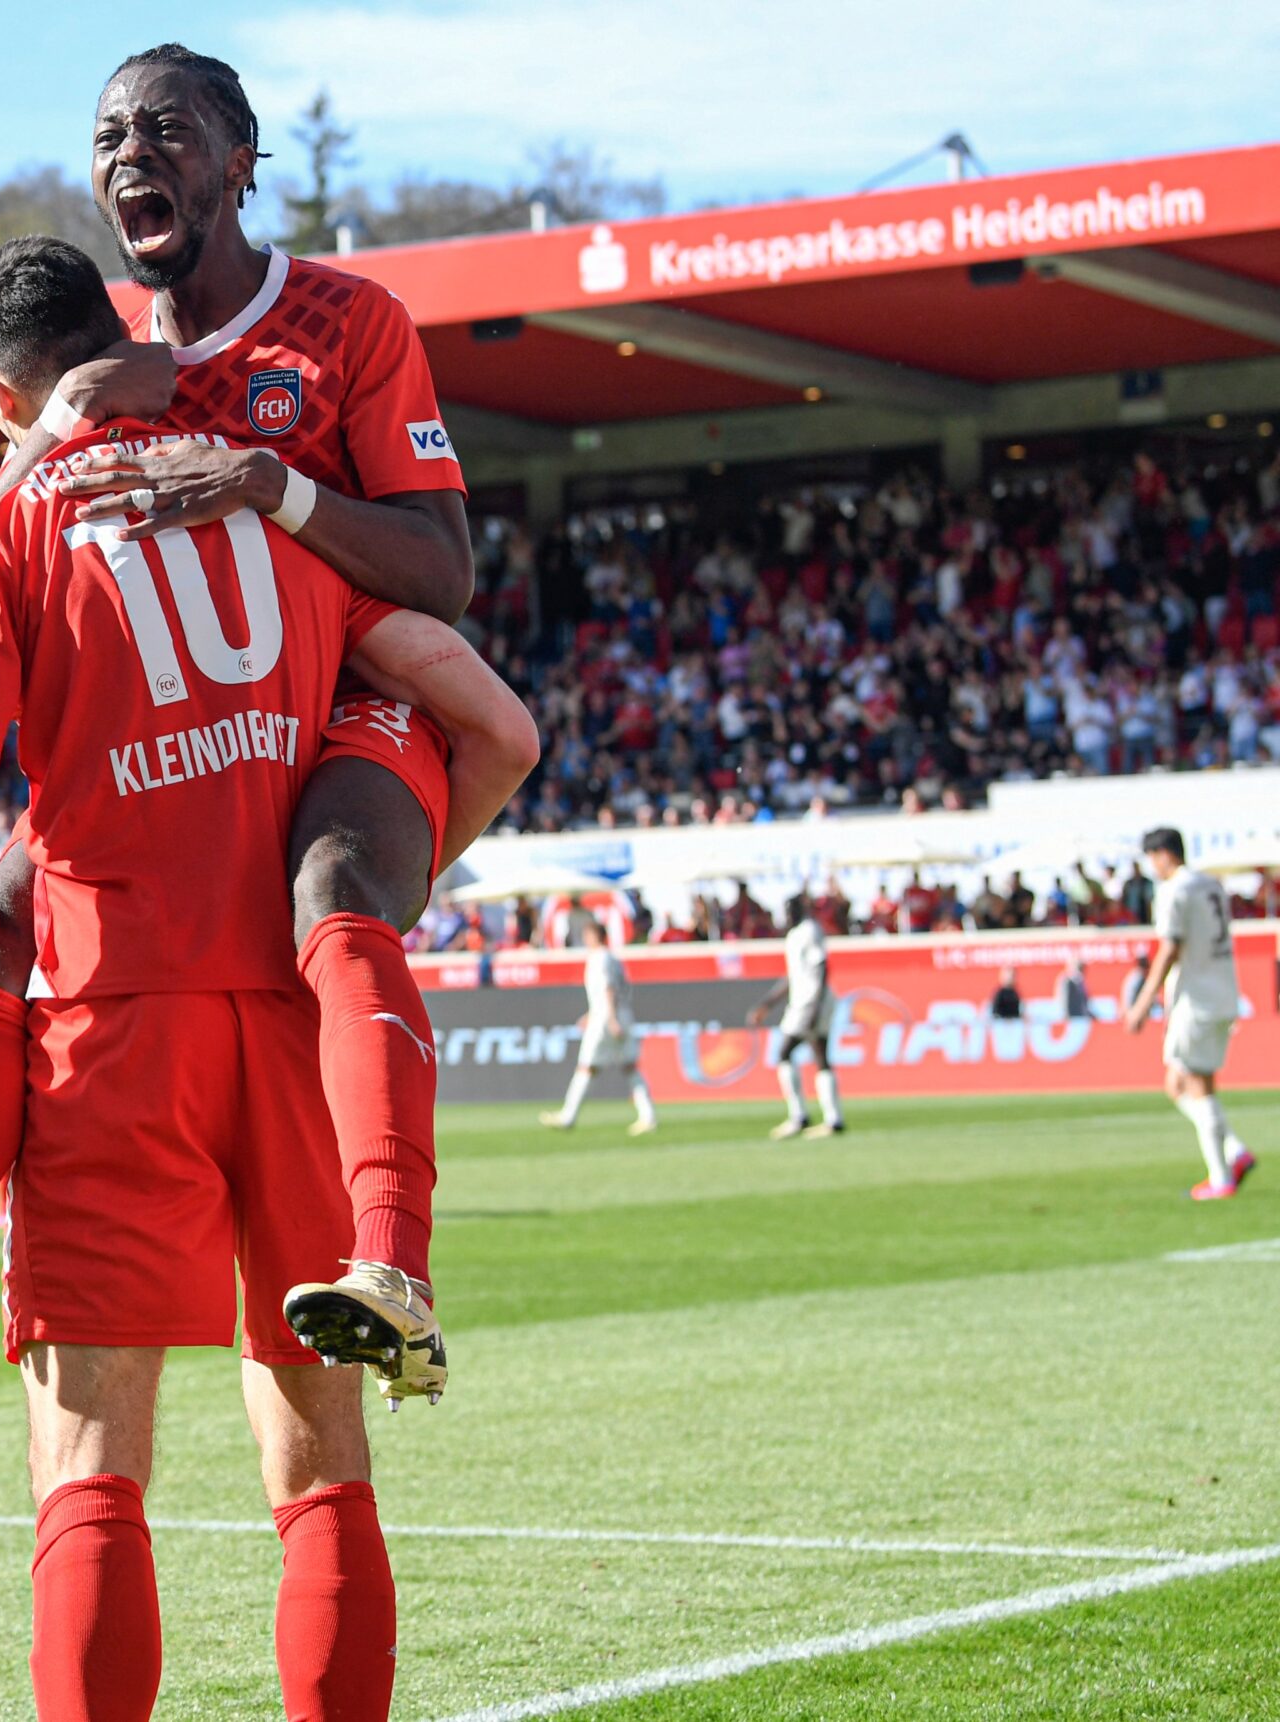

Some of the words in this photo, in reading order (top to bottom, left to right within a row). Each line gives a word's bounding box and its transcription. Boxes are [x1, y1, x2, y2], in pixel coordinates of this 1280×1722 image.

[650, 217, 945, 286] Kreissparkasse
[951, 181, 1205, 250] Heidenheim
[258, 399, 290, 420] FCH
[61, 492, 283, 706] 10
[160, 680, 176, 692] FCH
